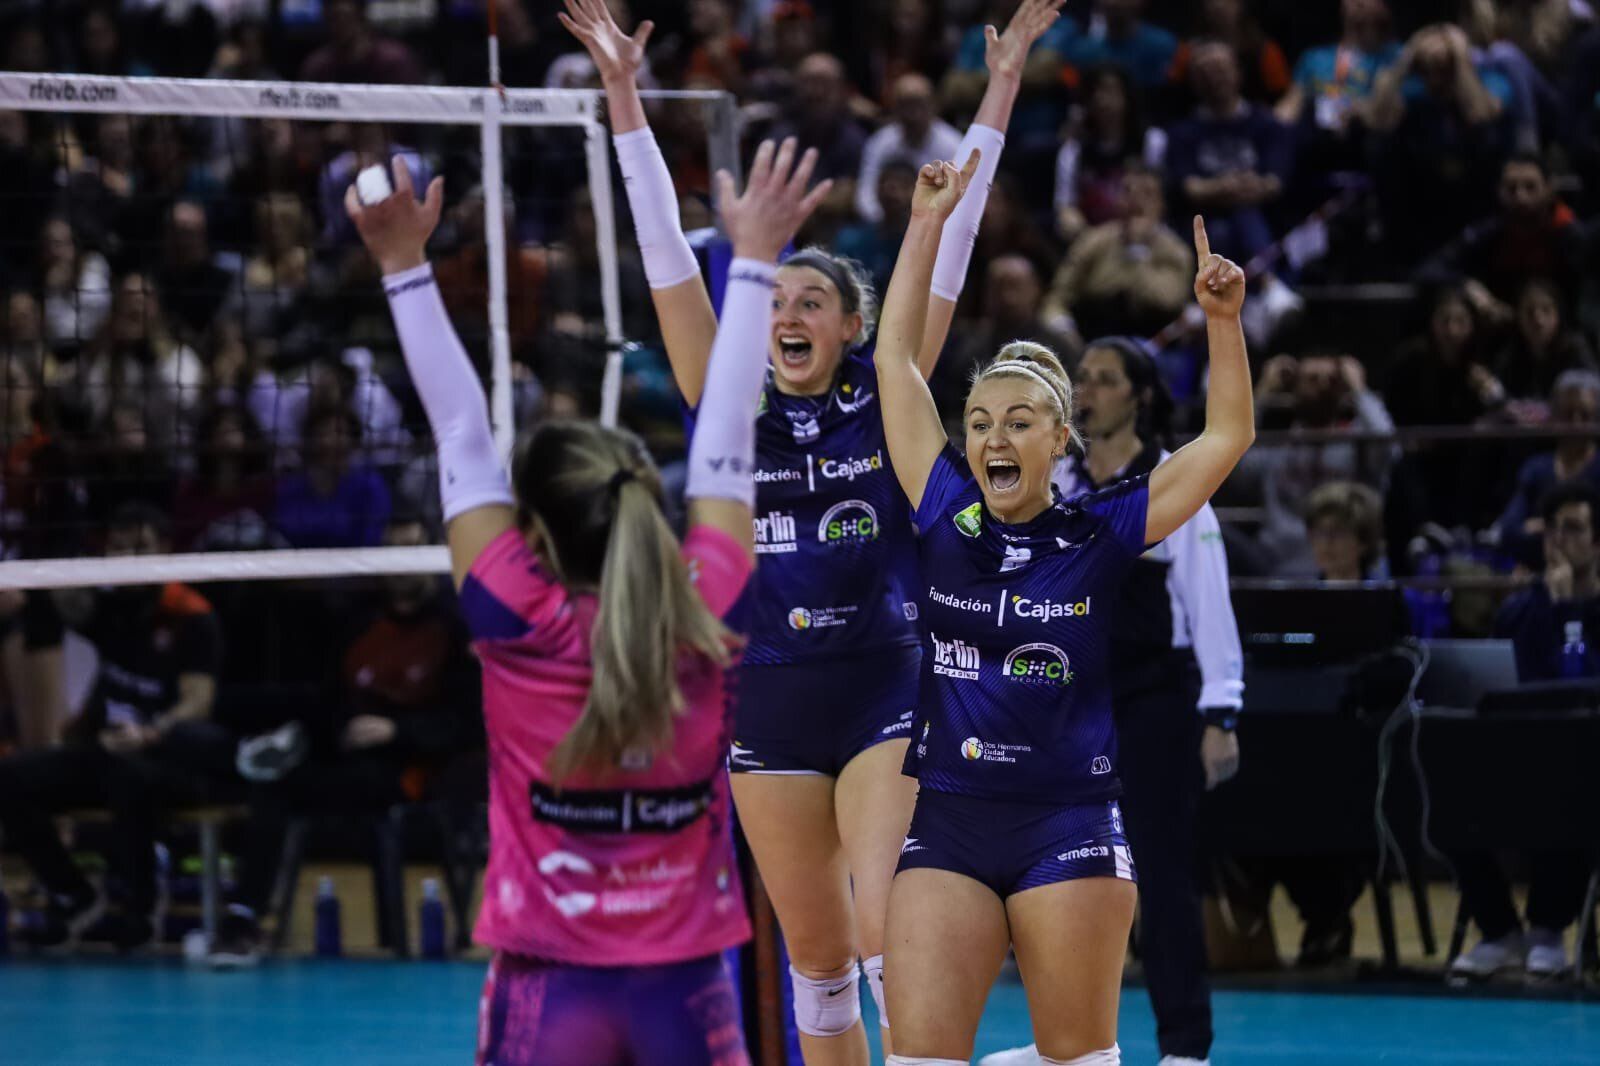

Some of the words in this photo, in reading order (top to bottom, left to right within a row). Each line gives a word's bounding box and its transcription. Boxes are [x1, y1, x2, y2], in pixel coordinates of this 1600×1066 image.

[751, 468, 802, 483] dación
[822, 449, 883, 482] Cajasol
[752, 511, 797, 543] erlin
[928, 586, 992, 613] Fundación
[1013, 596, 1091, 623] Cajasol
